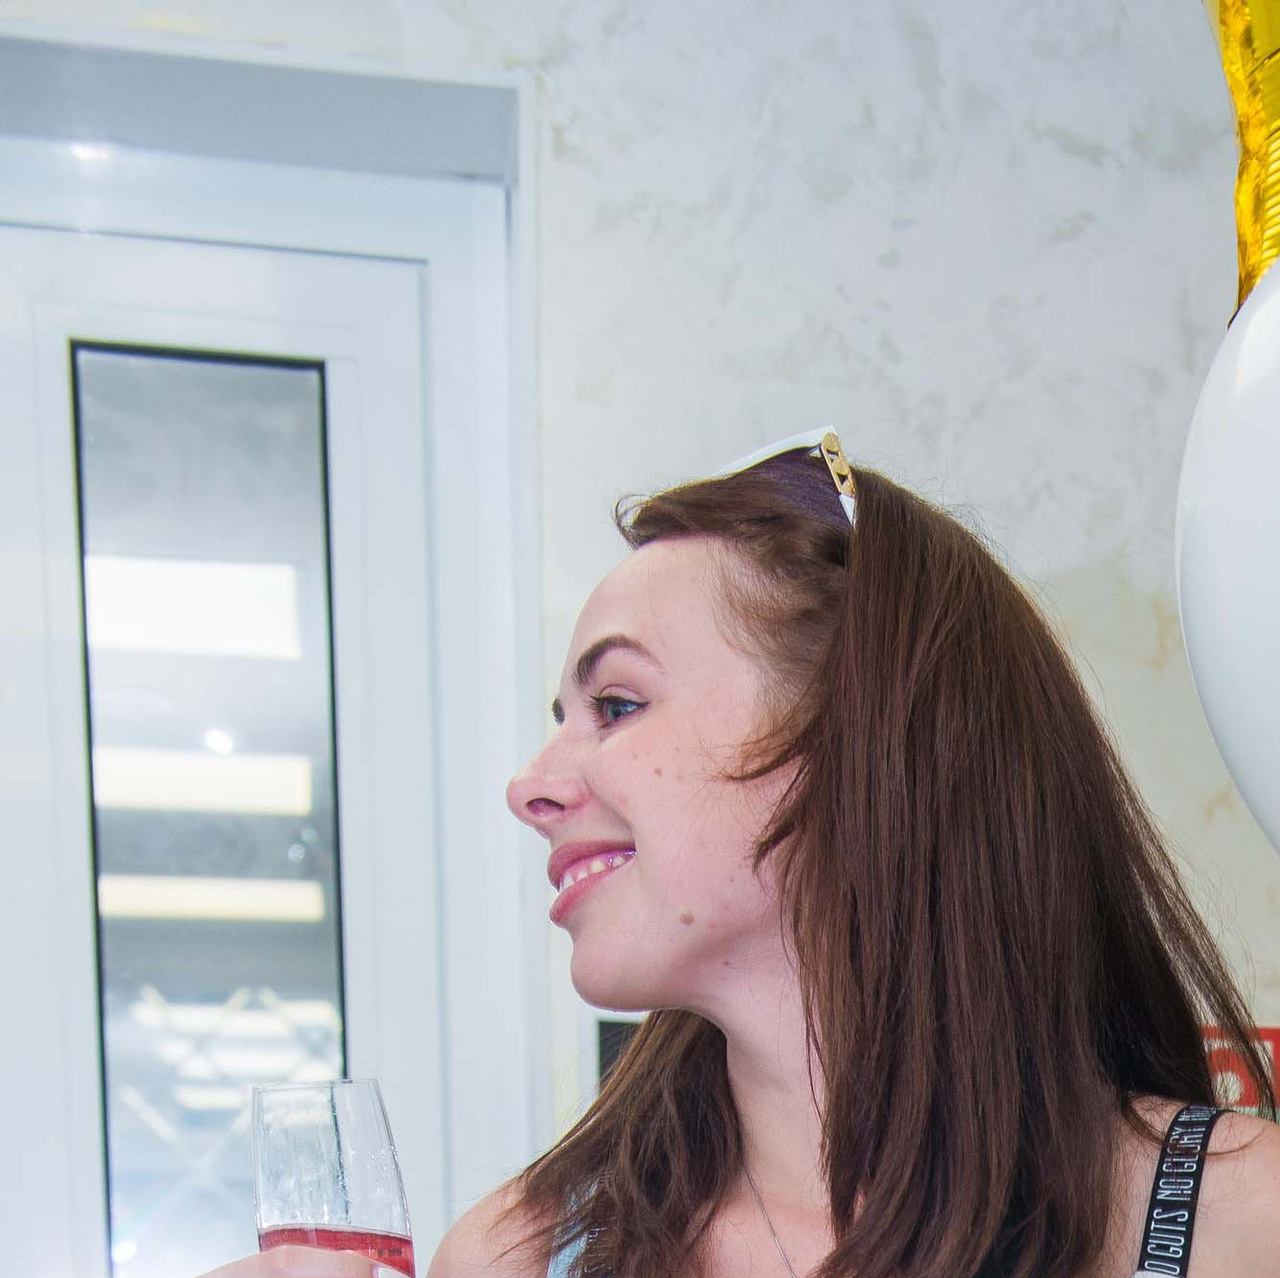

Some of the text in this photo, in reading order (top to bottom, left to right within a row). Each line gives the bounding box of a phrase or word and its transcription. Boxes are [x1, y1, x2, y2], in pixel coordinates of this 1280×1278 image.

[1162, 1126, 1206, 1173] GLORY
[1156, 1178, 1194, 1201] NO
[1147, 1208, 1189, 1258] GUTS
